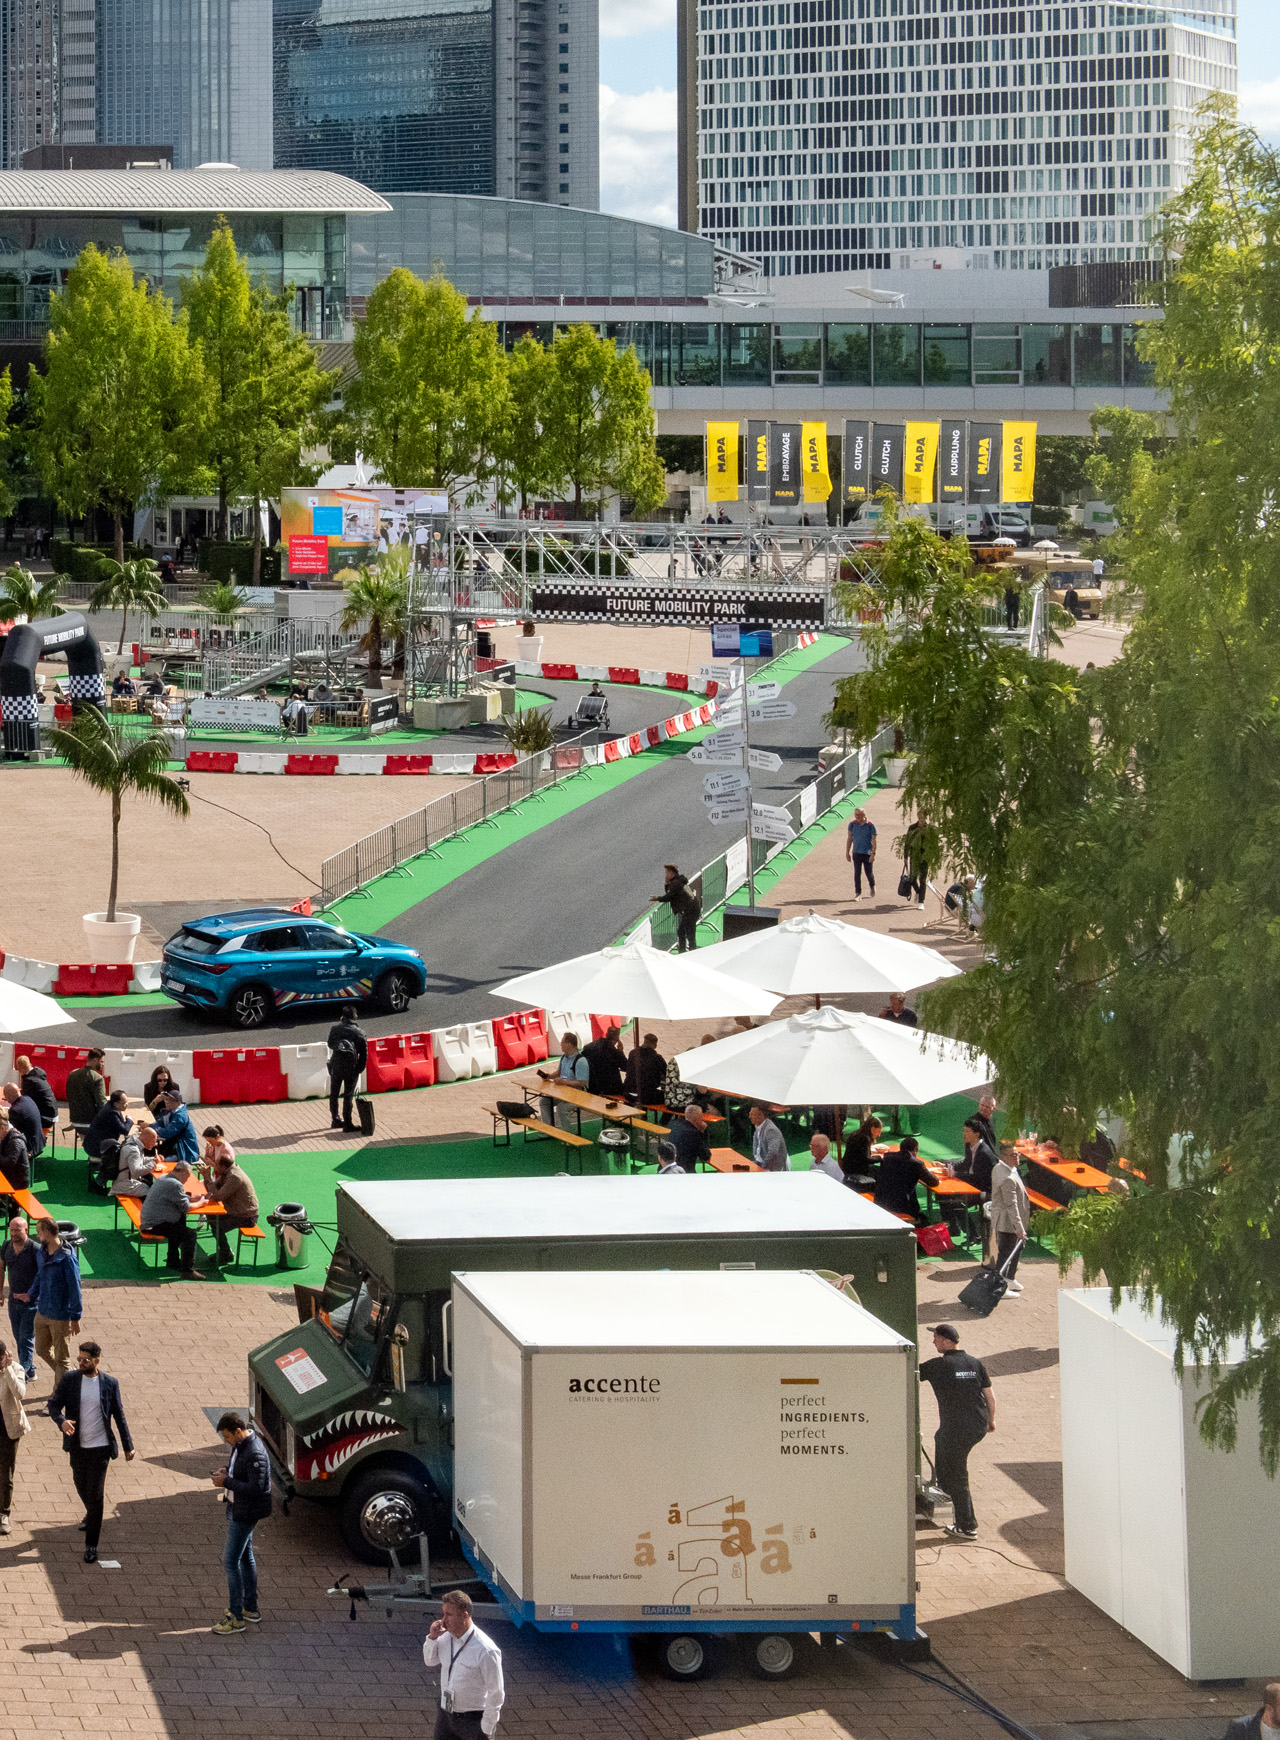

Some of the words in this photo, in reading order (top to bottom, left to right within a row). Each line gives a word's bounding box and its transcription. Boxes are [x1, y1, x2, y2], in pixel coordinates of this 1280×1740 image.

[718, 436, 726, 473] MAPA
[757, 434, 767, 472] MAPA
[782, 432, 791, 482] EMBRAYAGE
[809, 437, 820, 473] MAPA
[854, 436, 864, 470] CLUTCH
[881, 439, 891, 475] CLUTCH
[914, 437, 926, 473] MAPA
[950, 429, 961, 476] KUPPLUNG
[977, 437, 990, 475] MAPA
[1013, 436, 1024, 473] MAPA
[606, 598, 651, 612] FUTURE
[654, 600, 710, 615] MOBILITY
[714, 602, 746, 616] PARK
[751, 710, 761, 718] 3.0
[754, 826, 764, 834] 12.1
[568, 1375, 661, 1393] accente
[780, 1394, 826, 1410] perfect
[780, 1412, 870, 1424] INGREDIENTS,
[780, 1426, 826, 1442] perfect
[780, 1445, 849, 1455] MOMENTS.
[592, 1572, 622, 1580] Frankfurt
[622, 1573, 642, 1582] Group
